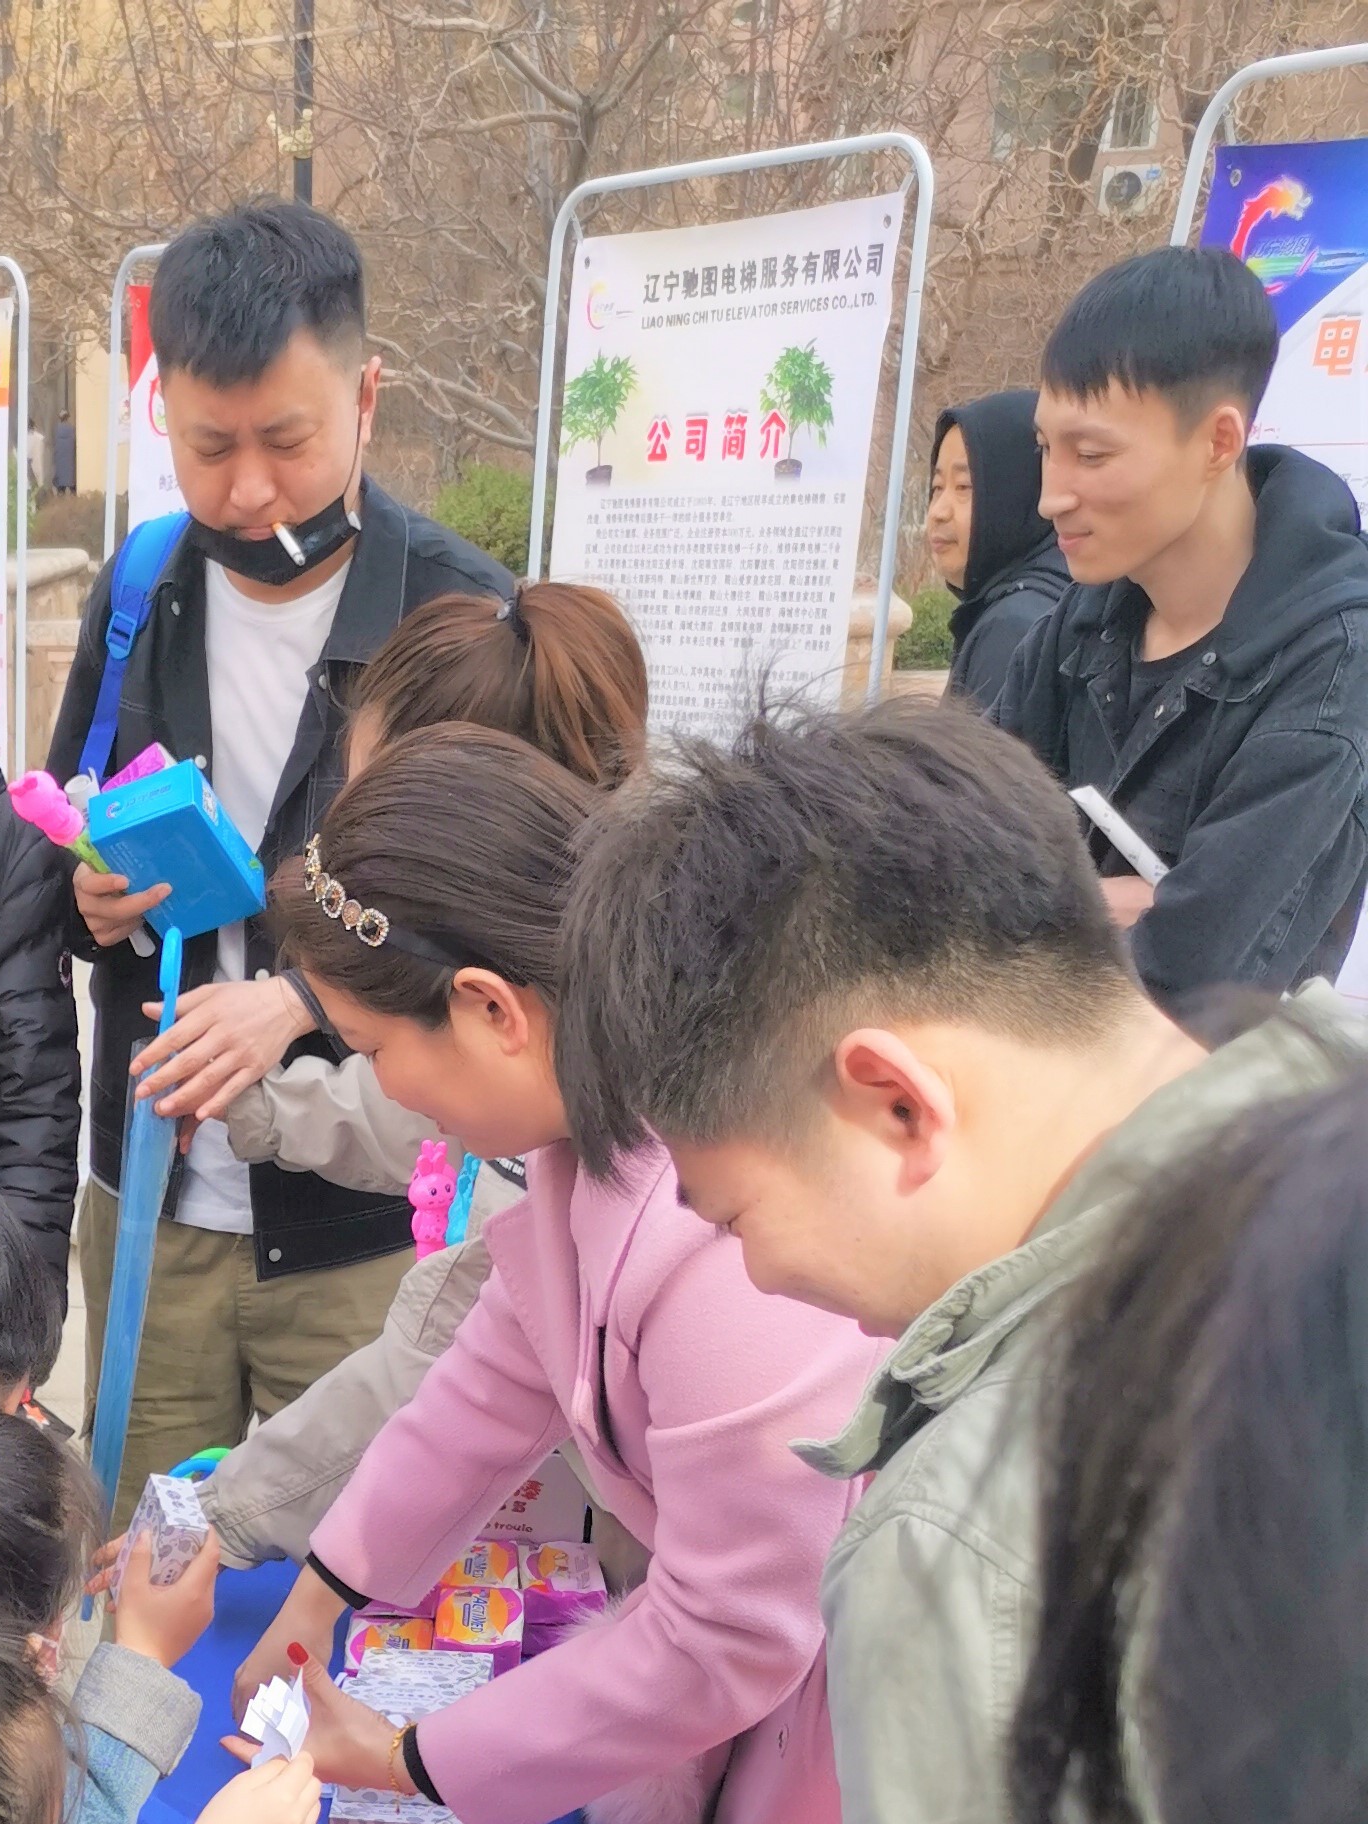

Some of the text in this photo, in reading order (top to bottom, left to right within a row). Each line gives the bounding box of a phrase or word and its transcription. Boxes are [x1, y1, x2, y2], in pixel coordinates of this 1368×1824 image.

[642, 242, 885, 304] 辽宁驰图电梯服务有限公司
[641, 312, 664, 330] LIAO
[665, 312, 691, 328] NING
[692, 309, 709, 324] CHI
[710, 307, 724, 323] TU
[725, 300, 779, 322] ELEVATOR
[780, 295, 830, 316] SERVICES
[646, 411, 787, 462] 公司简介
